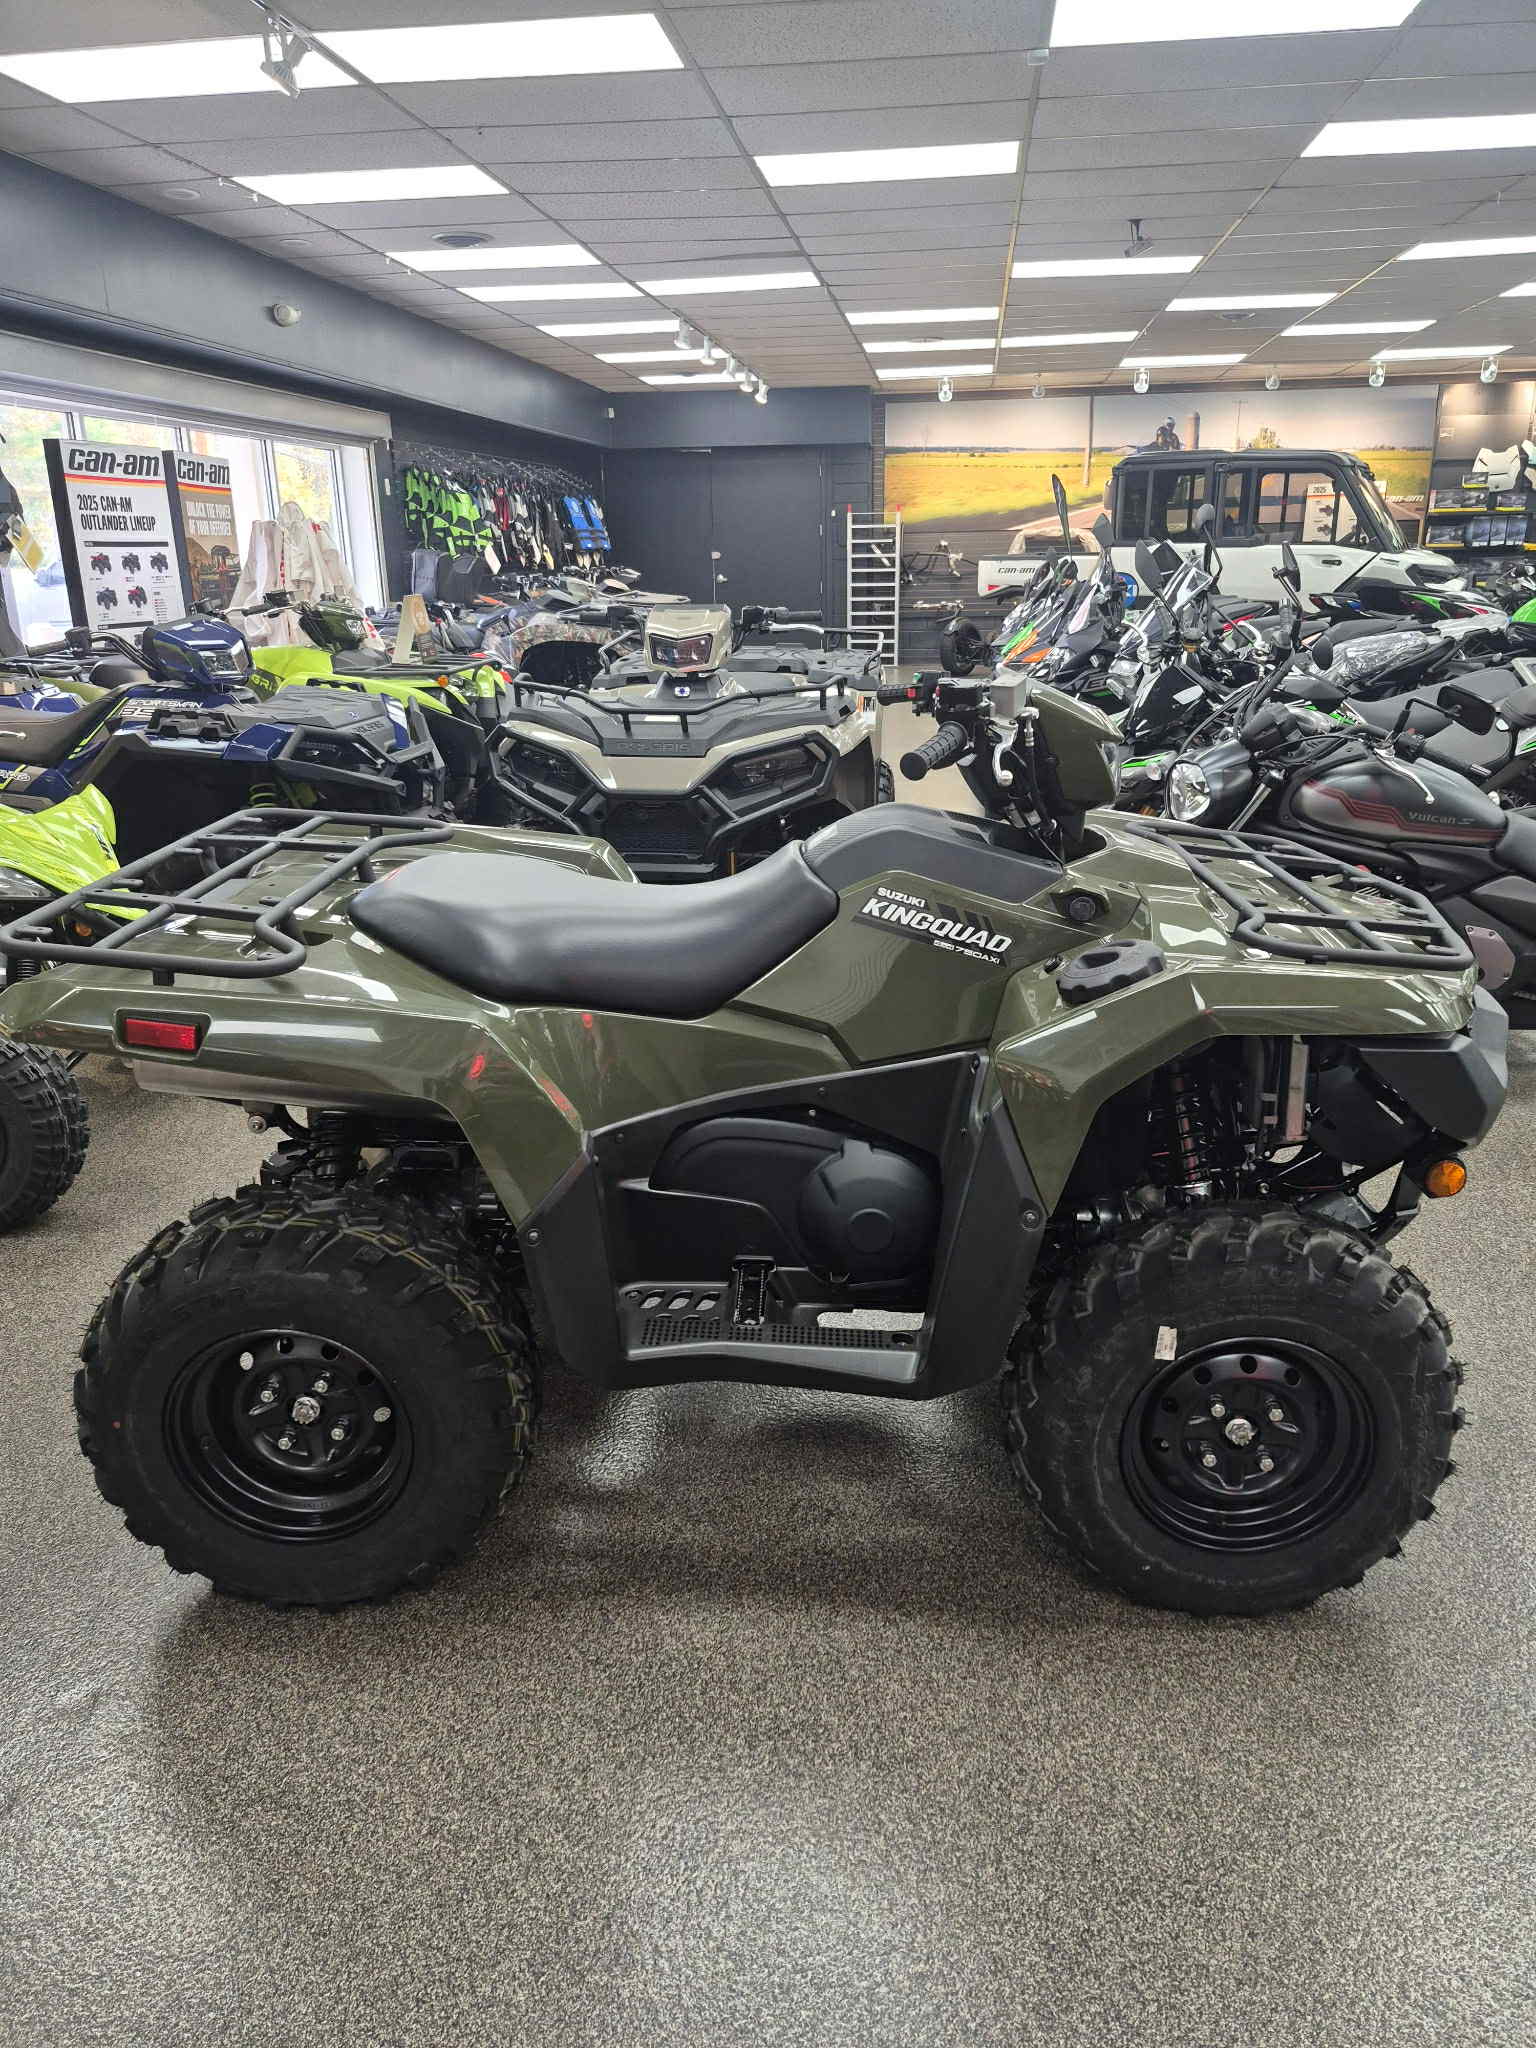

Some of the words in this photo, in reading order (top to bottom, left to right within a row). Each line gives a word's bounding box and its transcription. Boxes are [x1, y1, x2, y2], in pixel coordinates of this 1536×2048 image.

[69, 449, 160, 476] can-am
[177, 459, 230, 485] can-am
[77, 494, 99, 511] 2025
[100, 496, 133, 512] CAN-AM
[81, 514, 128, 531] OUTLANDER
[130, 516, 156, 531] LINEUP
[128, 698, 204, 709] SPORTSMAN
[1408, 811, 1456, 824] Vulcan
[877, 887, 926, 908] SUZUKI
[861, 898, 1013, 953] KINGQUAD
